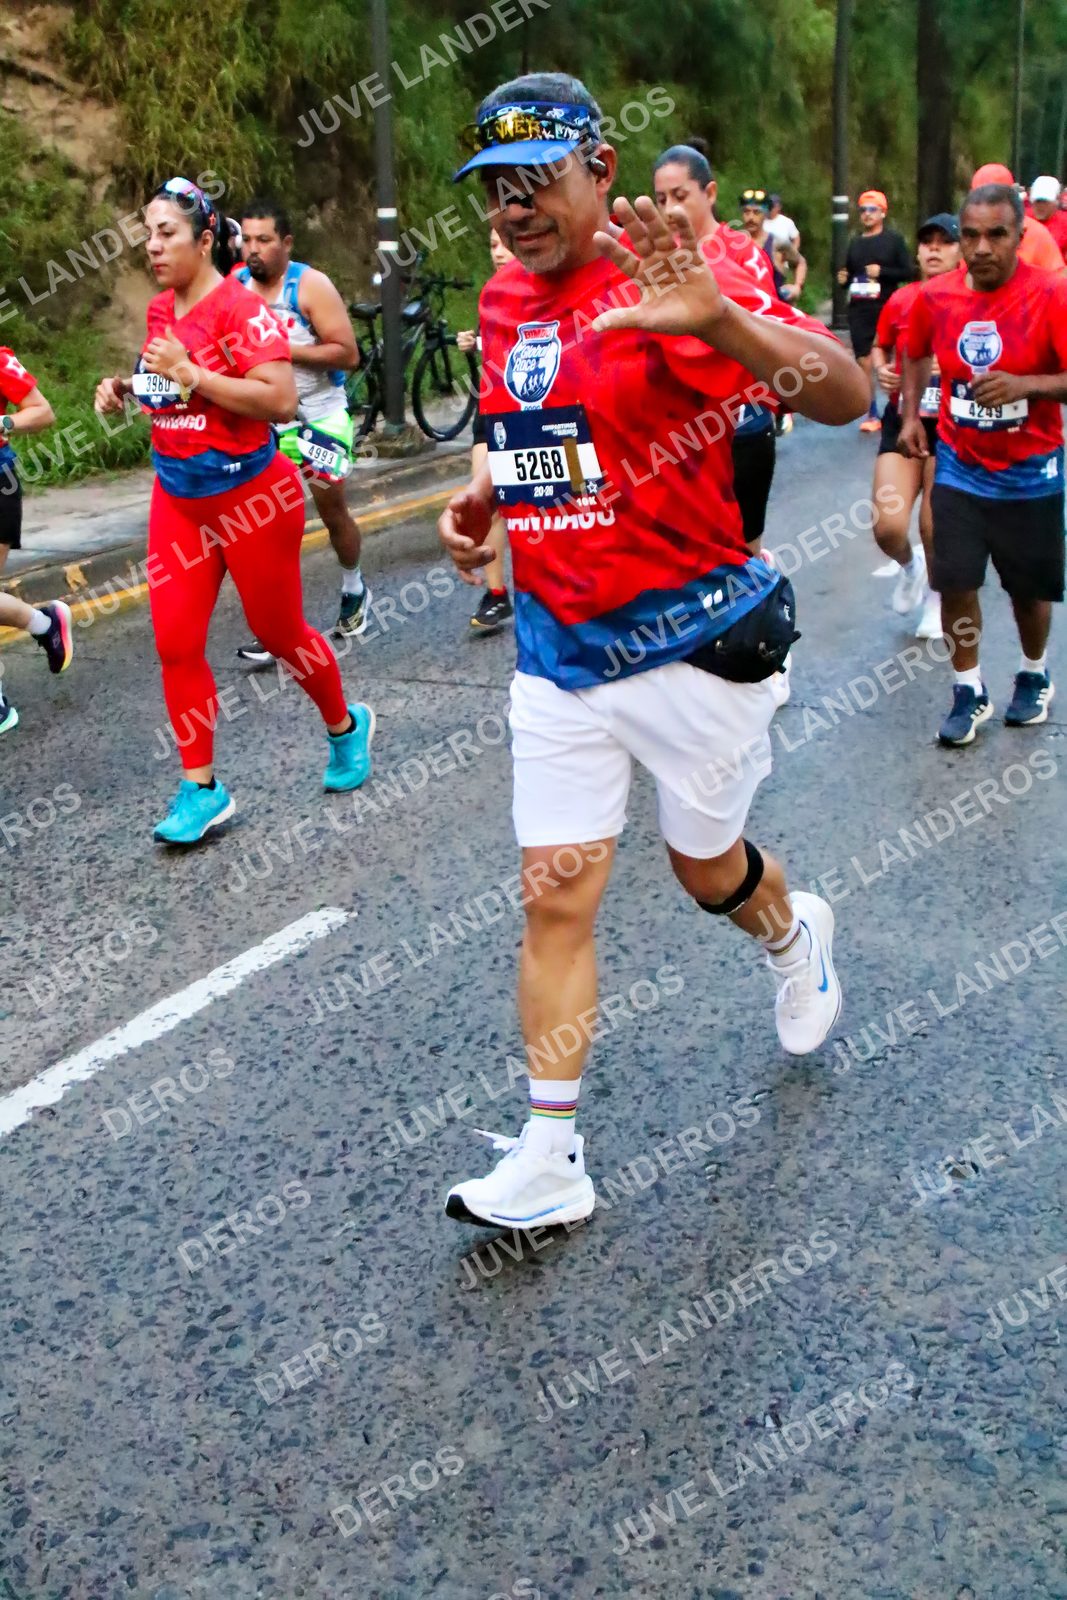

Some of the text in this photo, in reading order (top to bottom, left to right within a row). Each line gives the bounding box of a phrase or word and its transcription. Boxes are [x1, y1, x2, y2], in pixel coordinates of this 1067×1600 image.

[521, 344, 550, 358] Global
[513, 358, 536, 372] Race
[308, 445, 334, 465] 4993
[514, 449, 564, 481] 5268
[576, 496, 597, 507] 10K
